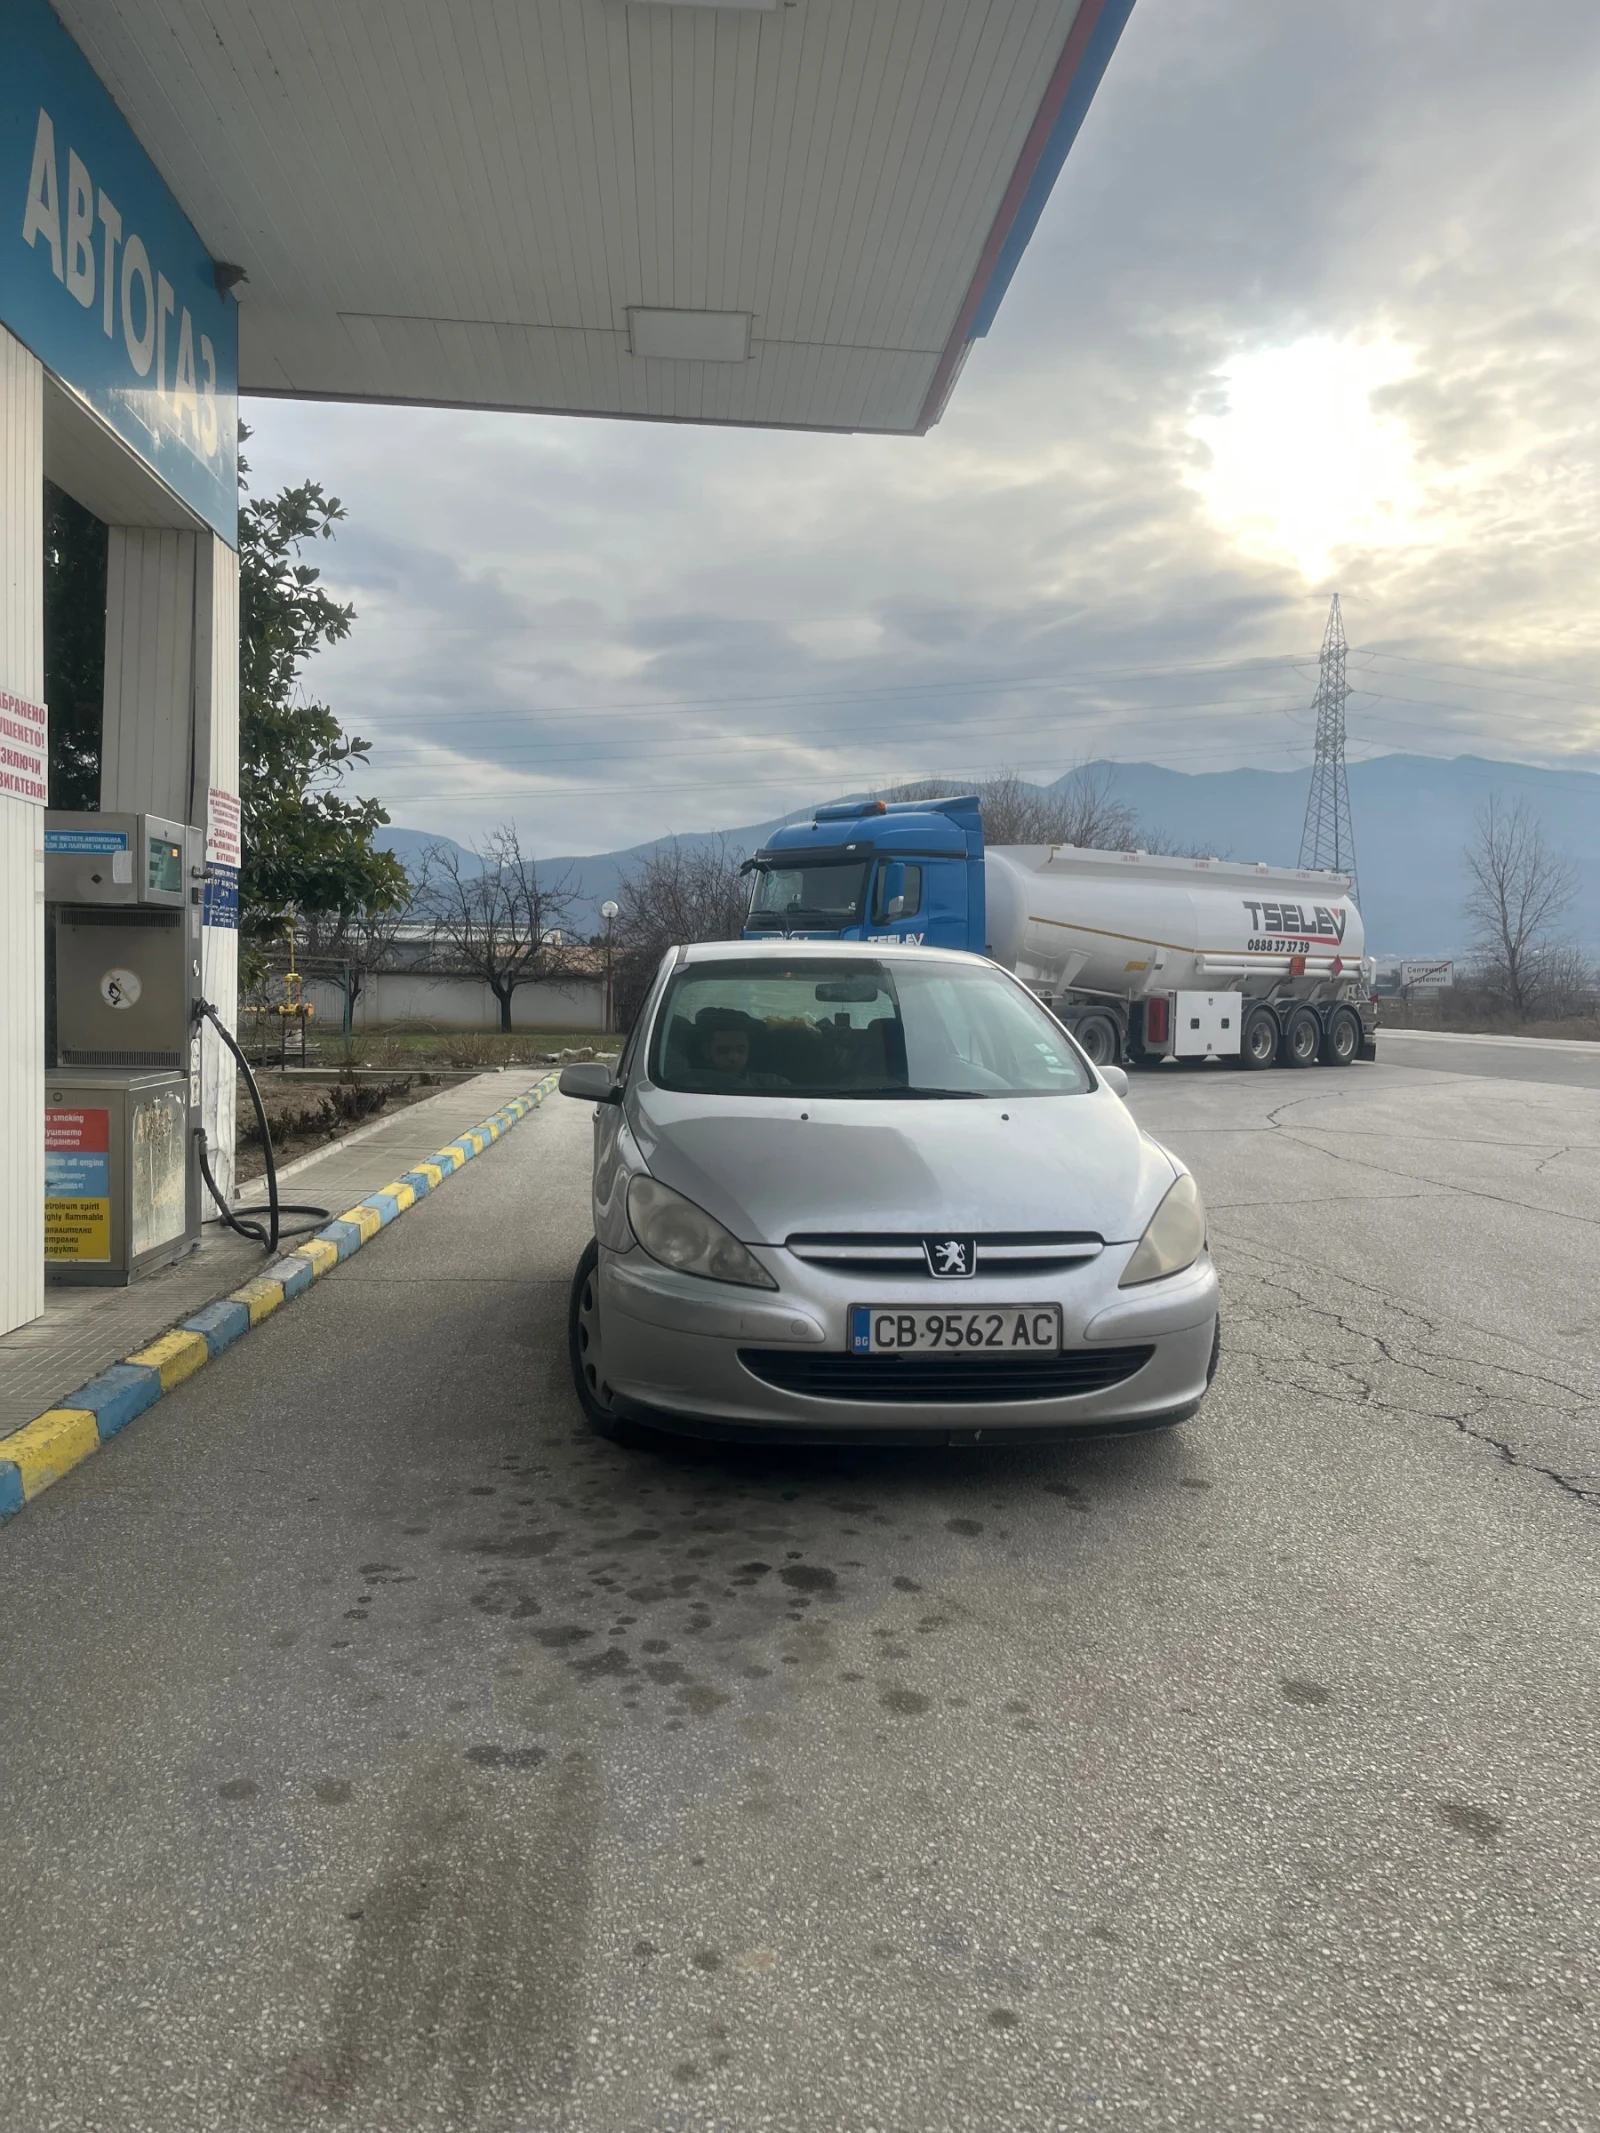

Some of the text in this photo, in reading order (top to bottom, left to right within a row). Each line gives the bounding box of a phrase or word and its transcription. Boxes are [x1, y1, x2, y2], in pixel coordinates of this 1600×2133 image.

[22, 107, 218, 458] АВТОГАЗ
[1242, 901, 1346, 944] TSELEV
[1247, 939, 1310, 953] 0888 37 37 39
[53, 1112, 84, 1124] smoking
[45, 1129, 82, 1137] ушенето
[79, 1158, 104, 1168] engine
[45, 1202, 100, 1211] etroleum spirit
[65, 1213, 104, 1221] flammable
[875, 1314, 1053, 1347] CB 9562 AC
[855, 1336, 869, 1347] BG
